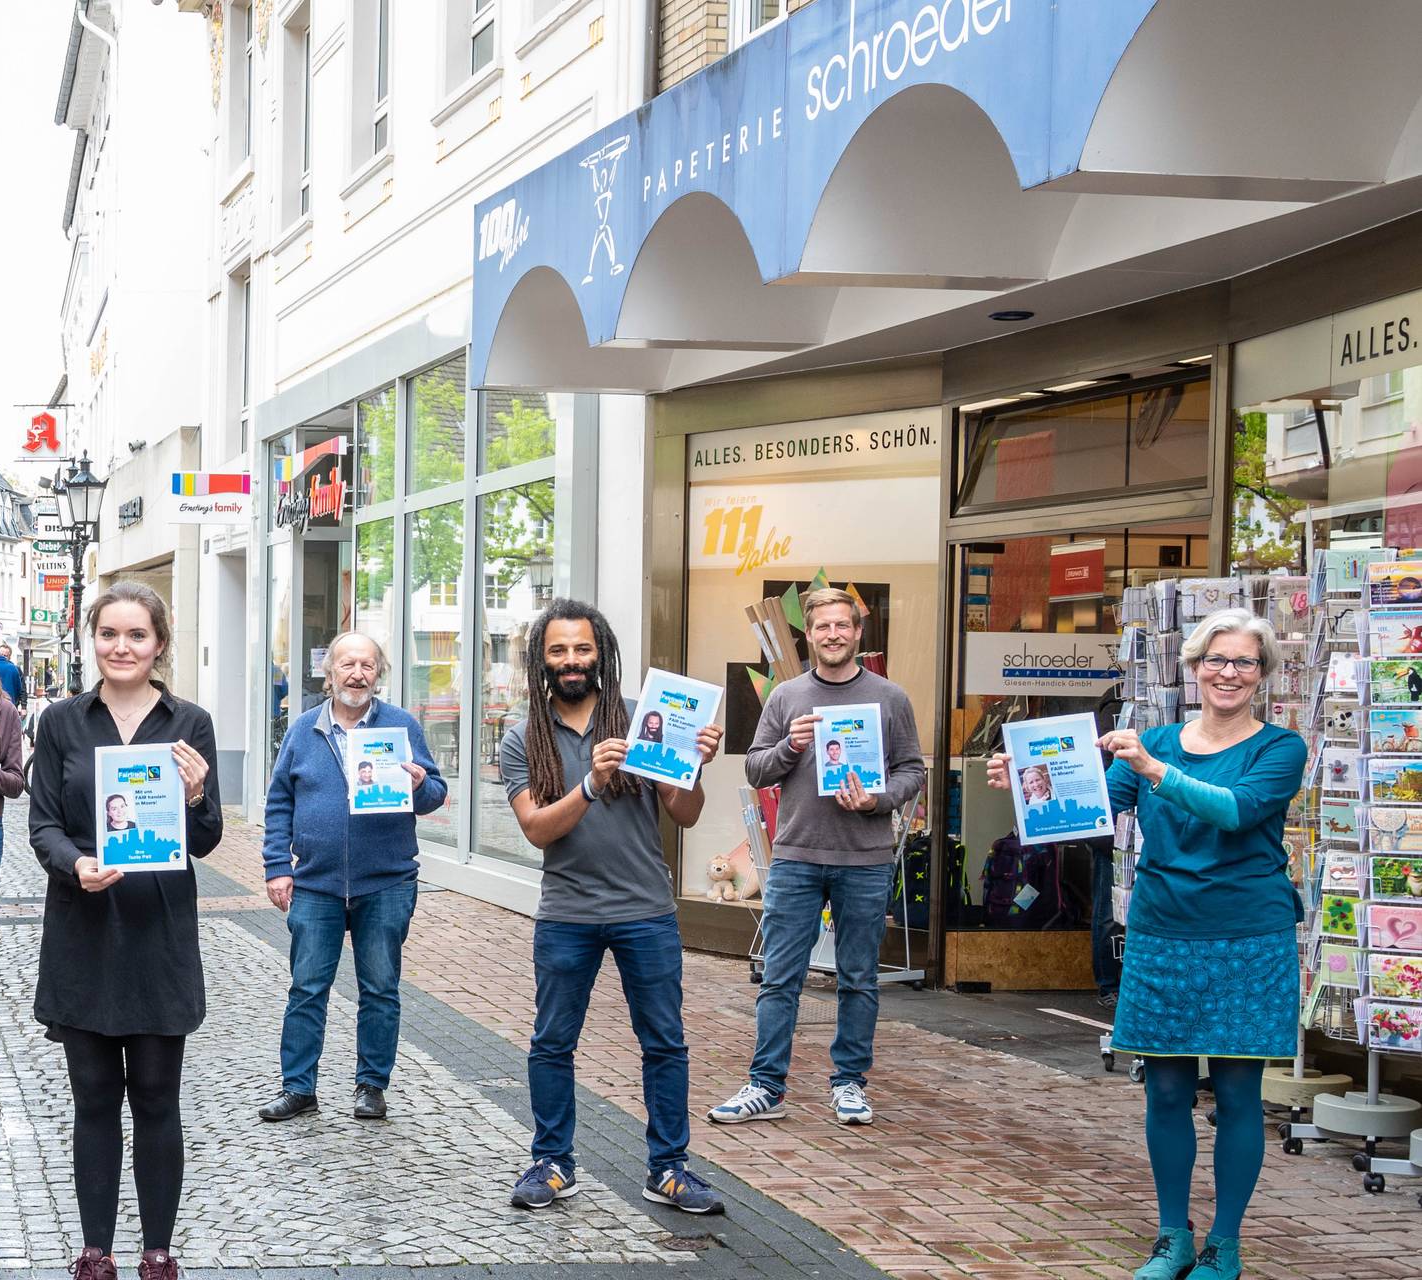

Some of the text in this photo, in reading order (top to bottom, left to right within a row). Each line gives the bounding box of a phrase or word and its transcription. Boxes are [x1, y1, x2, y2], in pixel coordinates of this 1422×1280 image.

[644, 108, 784, 203] PAPETERIE
[479, 198, 516, 262] 100
[1341, 316, 1418, 367] ALLES.
[694, 424, 937, 467] ALLES. BESONDERS. SCHÖN.
[214, 502, 242, 514] family
[702, 505, 763, 556] 111
[37, 562, 67, 570] VELTINS
[736, 526, 792, 577] Jahre
[1003, 642, 1094, 668] schroeder
